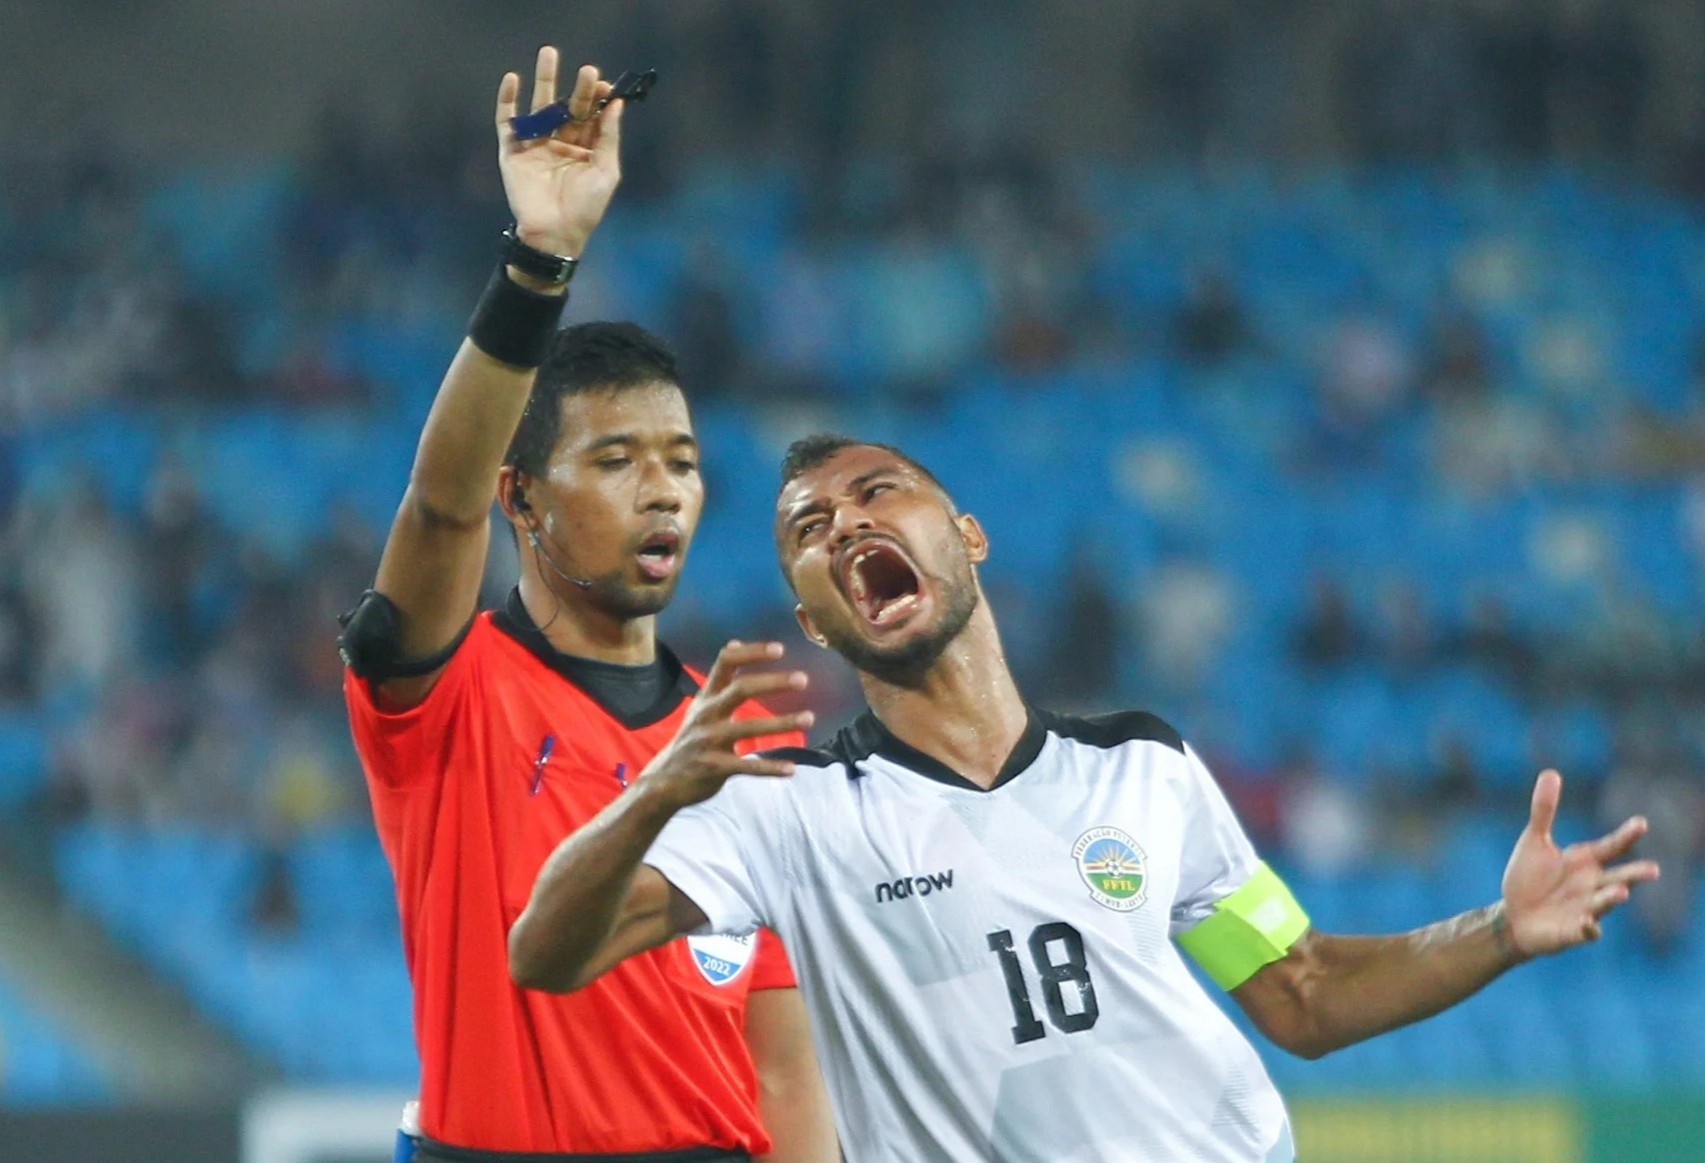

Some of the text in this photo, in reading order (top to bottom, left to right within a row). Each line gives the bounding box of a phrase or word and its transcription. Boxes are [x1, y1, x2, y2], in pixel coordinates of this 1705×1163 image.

[875, 869, 953, 903] narow
[1102, 879, 1136, 891] FFTL
[703, 955, 730, 976] 2022
[986, 921, 1100, 1045] 18
